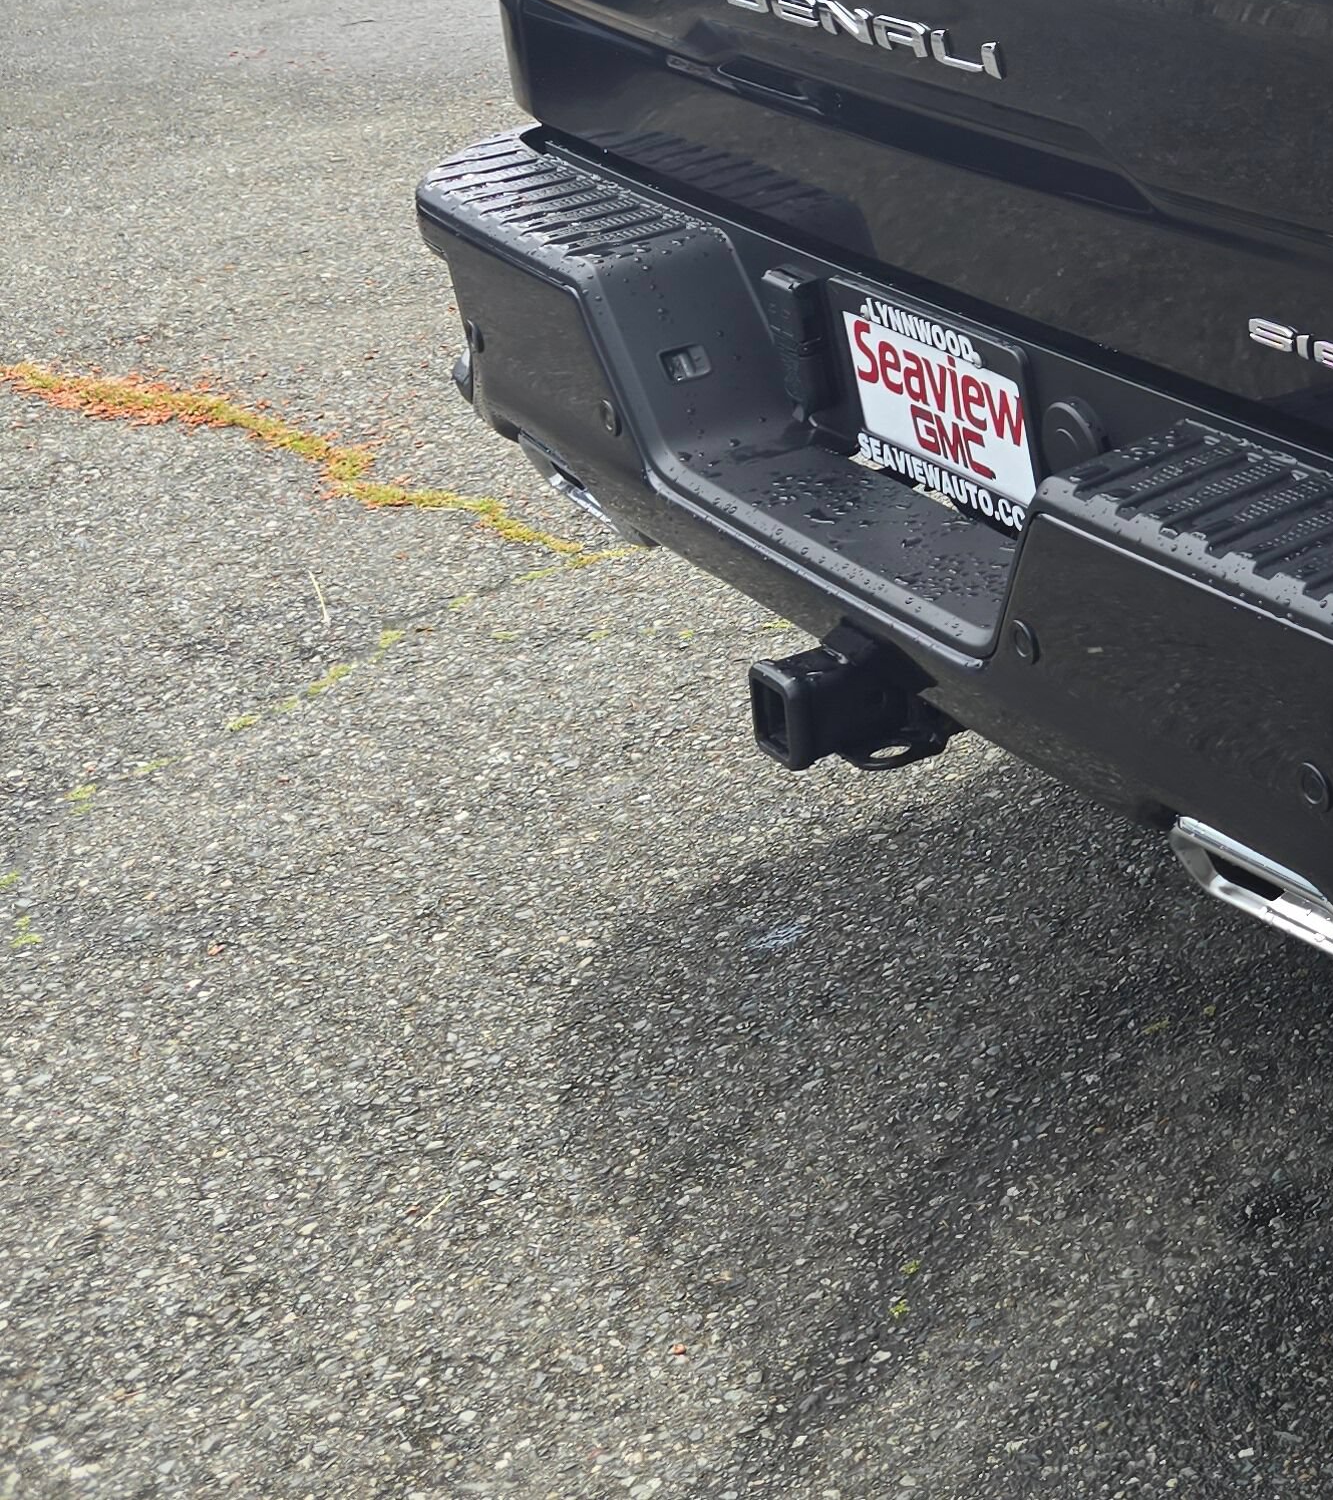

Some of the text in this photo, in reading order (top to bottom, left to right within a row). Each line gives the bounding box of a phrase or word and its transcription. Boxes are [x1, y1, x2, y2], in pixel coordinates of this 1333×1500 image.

[865, 297, 976, 363] LYNNWOOD
[853, 319, 1025, 447] Seaview
[910, 403, 996, 481] GMC
